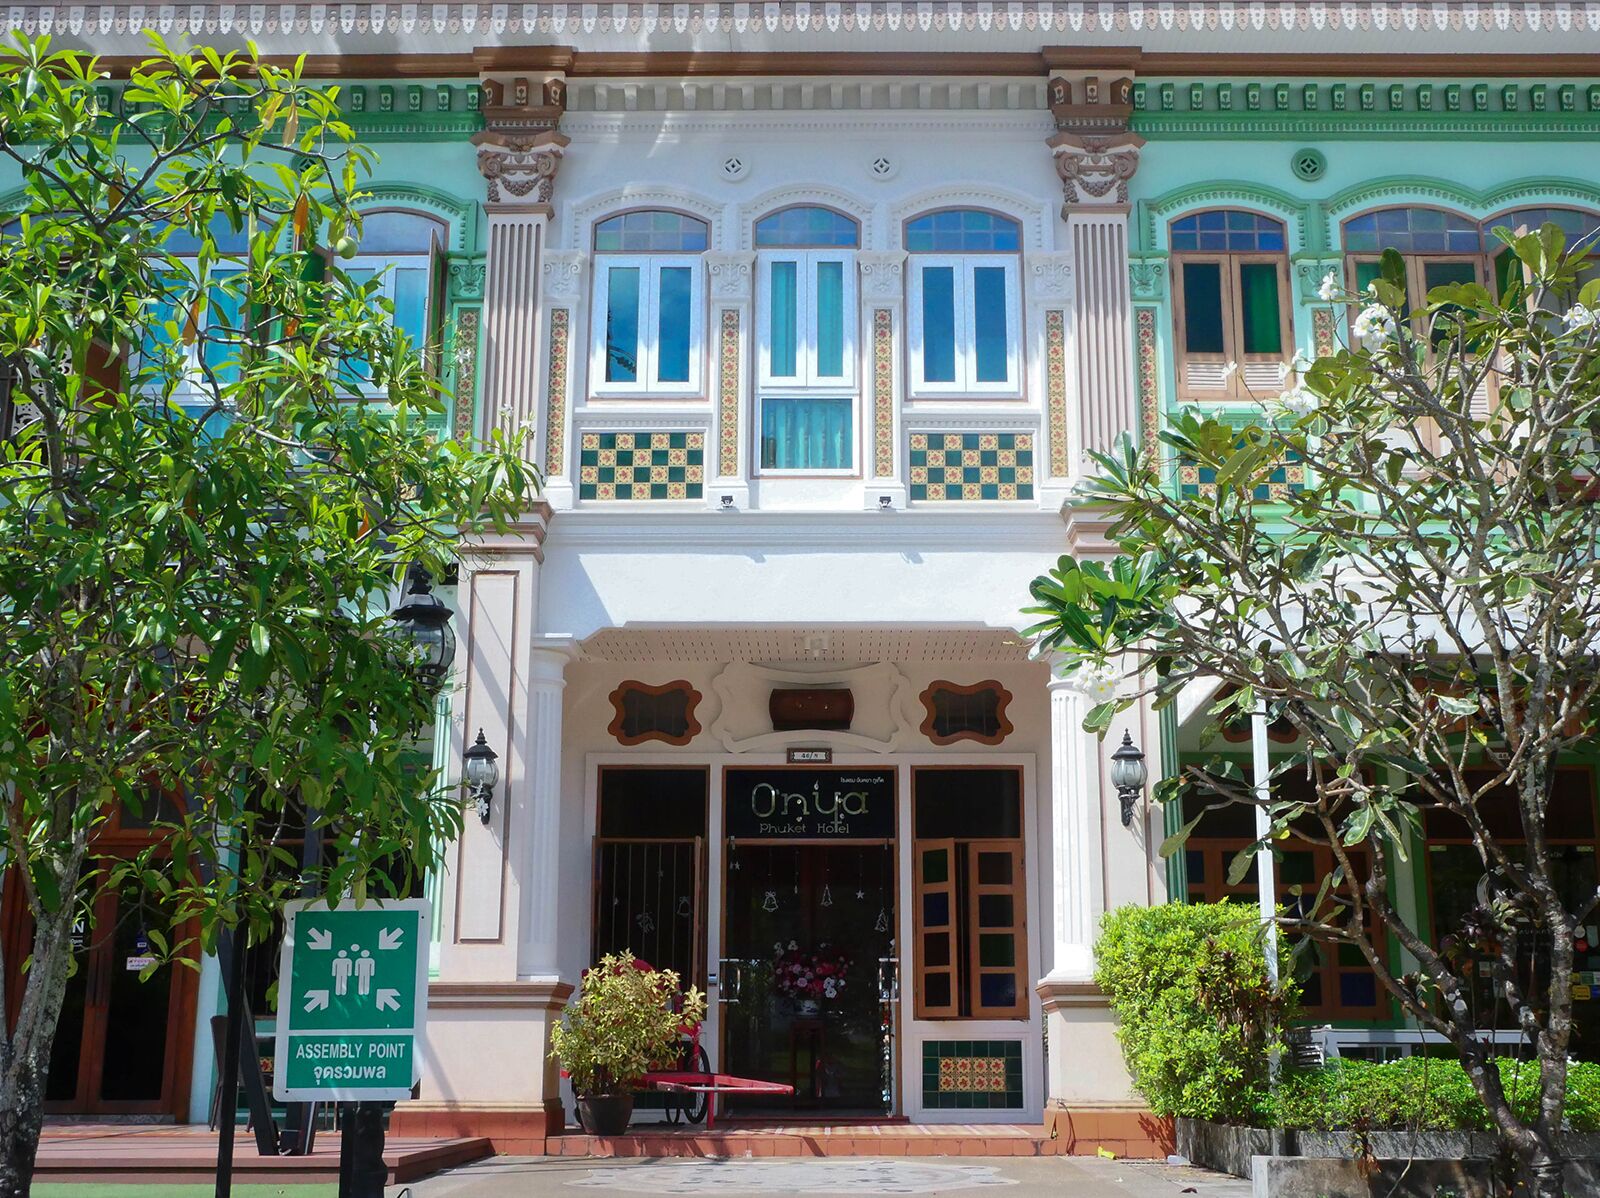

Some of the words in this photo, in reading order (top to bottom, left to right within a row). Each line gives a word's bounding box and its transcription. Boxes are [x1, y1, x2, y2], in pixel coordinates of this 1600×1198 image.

[759, 822, 807, 834] Phuket
[817, 822, 850, 834] Hotel
[296, 1043, 362, 1059] ASSEMBLY
[368, 1042, 406, 1059] POINT
[313, 1065, 387, 1086] จุดรวมพล
